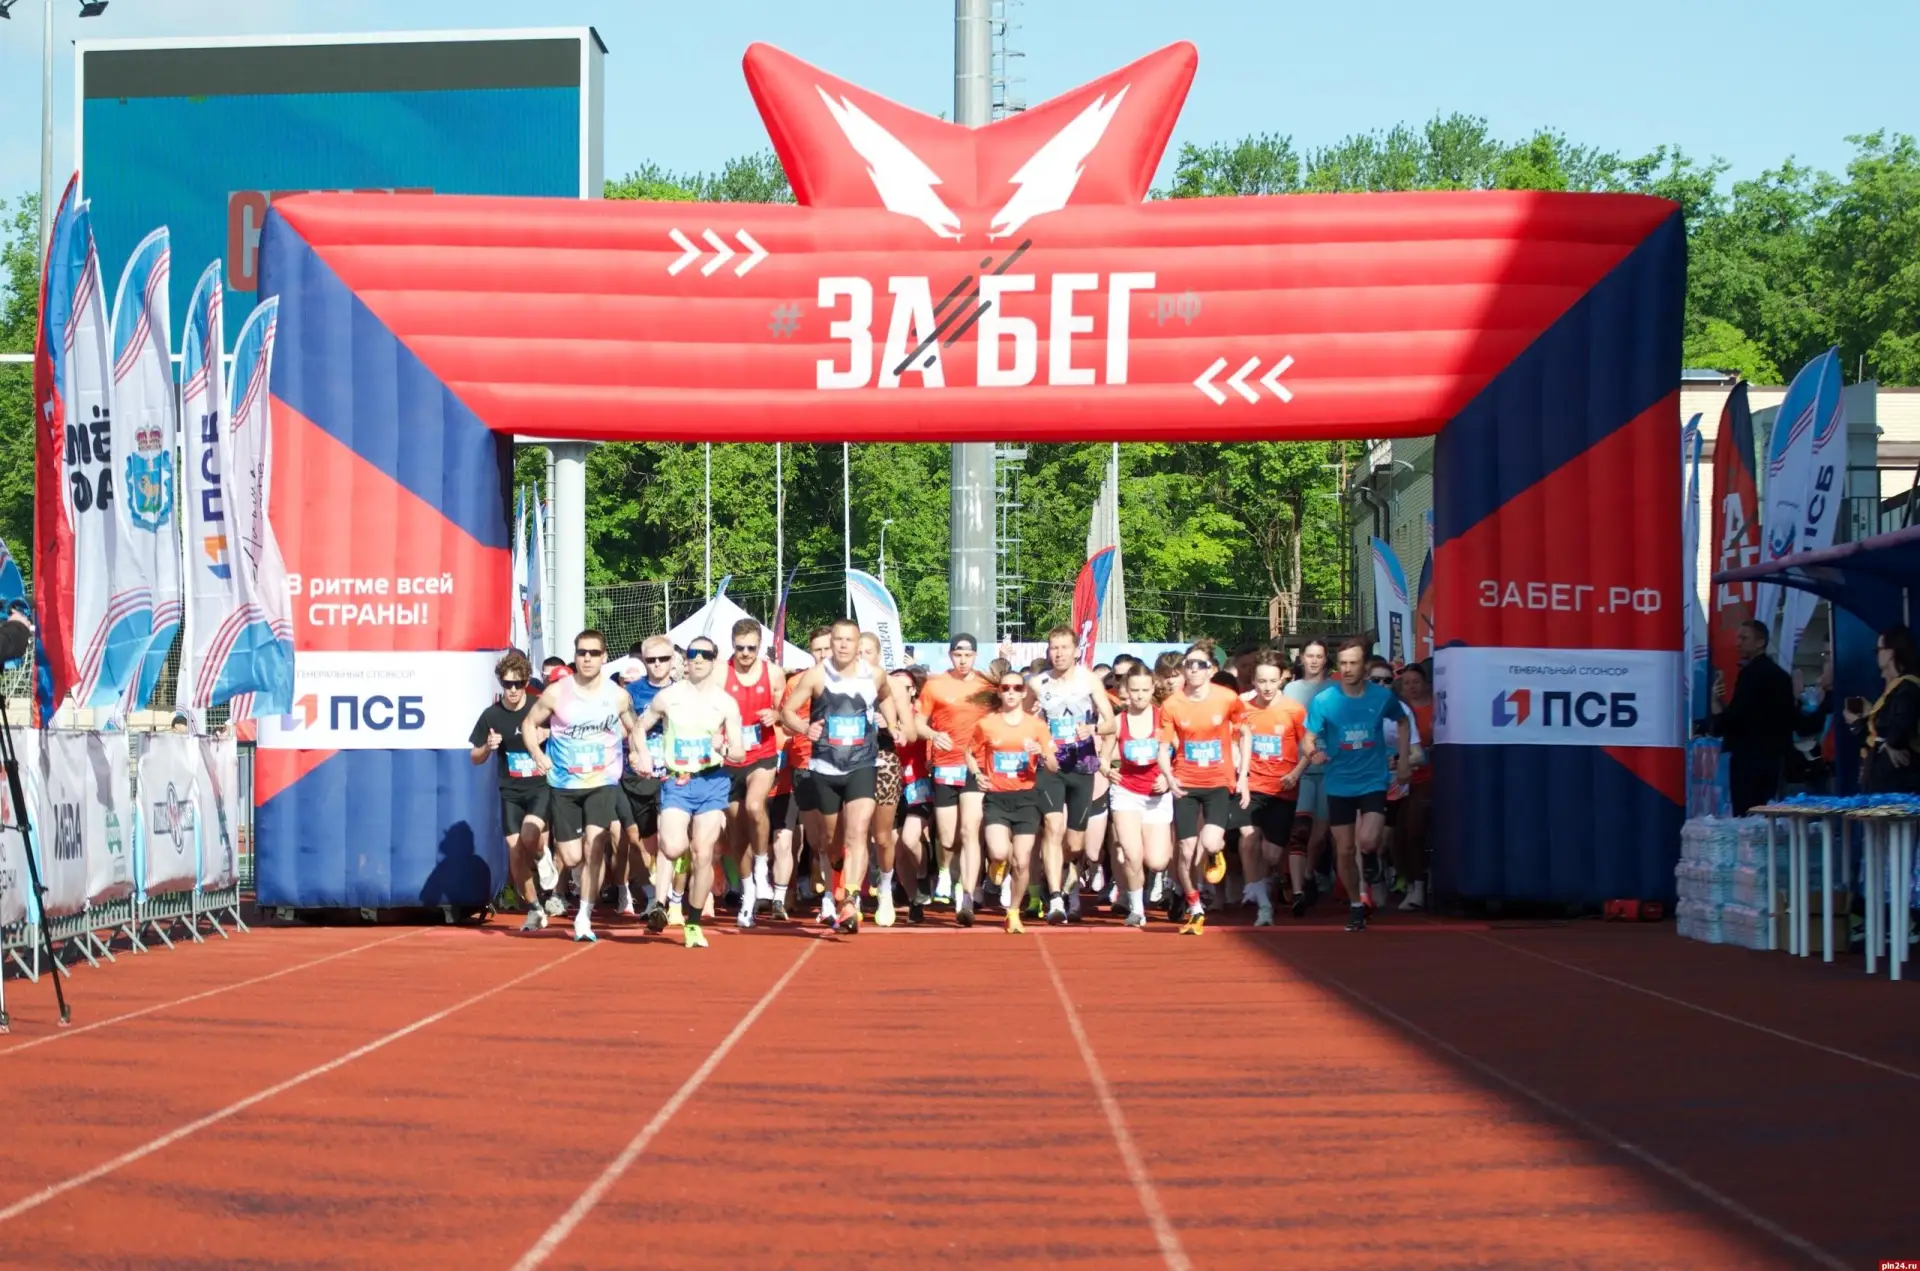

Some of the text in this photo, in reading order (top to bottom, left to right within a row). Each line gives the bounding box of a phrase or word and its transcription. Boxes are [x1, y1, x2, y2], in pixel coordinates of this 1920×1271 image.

[309, 577, 390, 599] ритме
[397, 572, 454, 595] всей
[1479, 580, 1662, 615] ЗАБЕГ.РФ
[308, 602, 429, 626] СТРАНЫ!
[1509, 664, 1629, 677] ГЕНЕРАЛЬНЫЙ СПОНСОР
[330, 695, 426, 731] ПСБ
[1543, 691, 1638, 728] ПСБ
